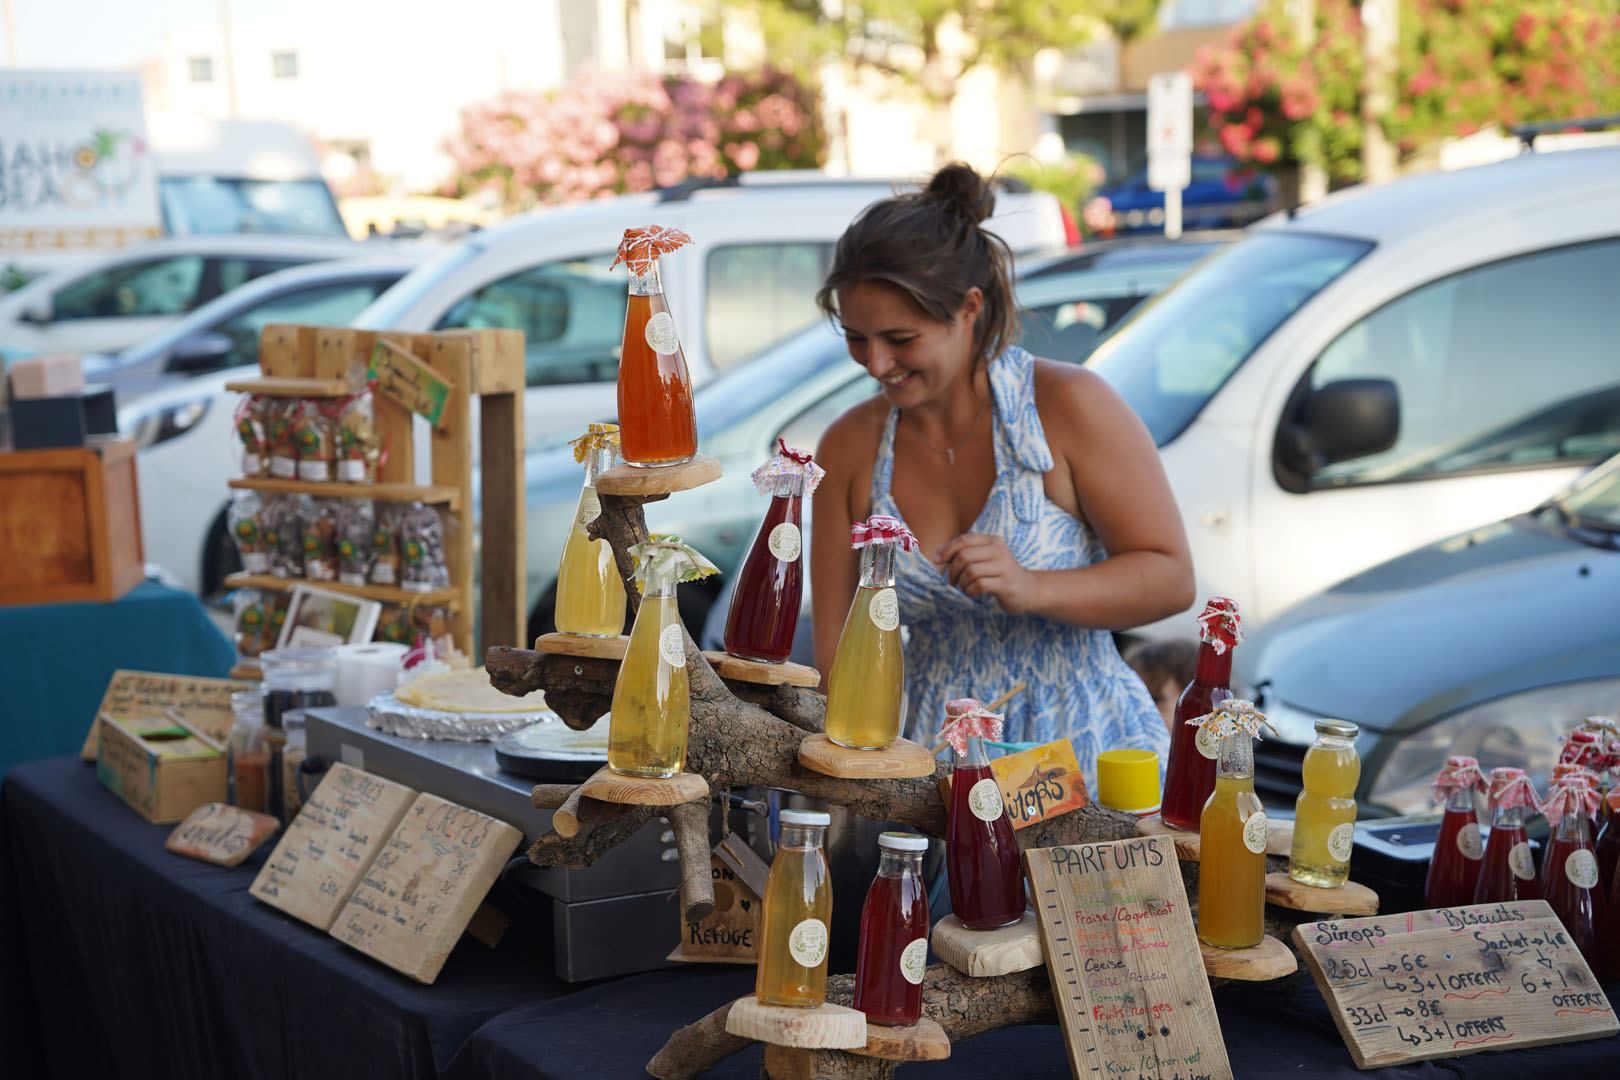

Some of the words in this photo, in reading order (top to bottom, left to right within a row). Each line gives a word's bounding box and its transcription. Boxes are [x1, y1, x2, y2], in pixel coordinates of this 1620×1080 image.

[1007, 772, 1064, 822] irops
[1052, 839, 1163, 875] PARFUMS
[711, 868, 734, 880] ON
[1436, 904, 1525, 932] Biscuits
[1316, 922, 1386, 948] Sirops
[1474, 931, 1528, 953] Sachet
[1085, 958, 1126, 972] Cerise
[1326, 958, 1373, 980] 25cl
[1448, 969, 1504, 991] OFFERT
[1090, 988, 1134, 1003] Pomme
[1552, 992, 1603, 1008] OFFERT
[1093, 1004, 1124, 1020] Fruits
[1131, 1003, 1172, 1019] rouges
[1346, 1003, 1389, 1026] 33cl
[1097, 1019, 1143, 1036] Menthe
[1456, 1016, 1507, 1038] OFFERT
